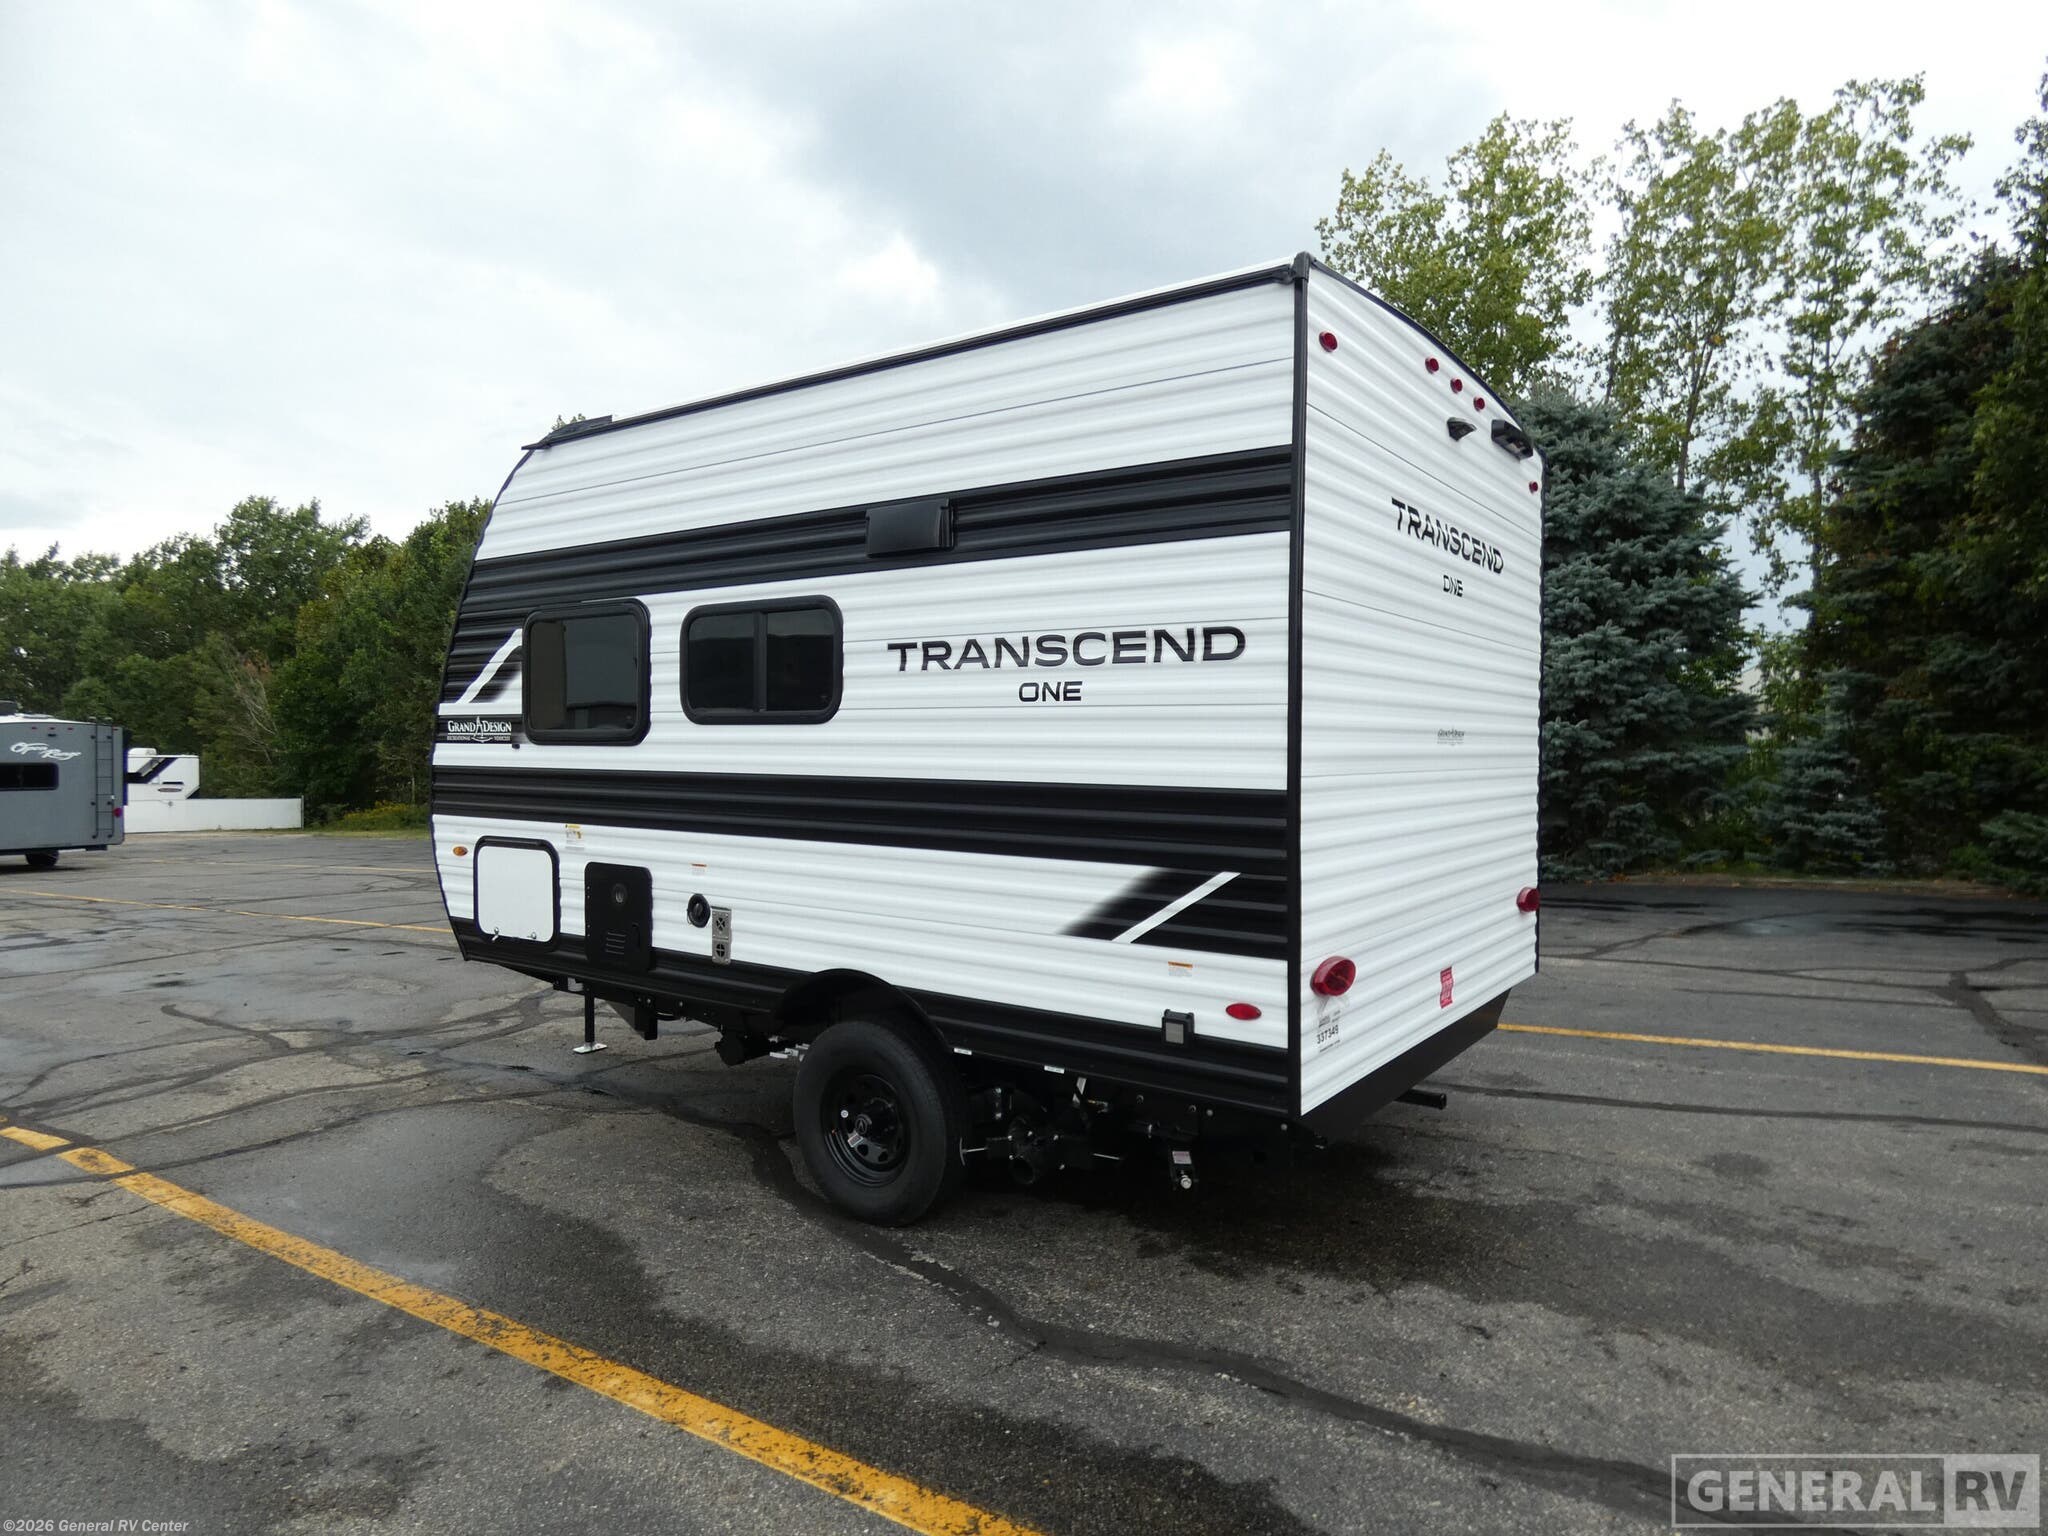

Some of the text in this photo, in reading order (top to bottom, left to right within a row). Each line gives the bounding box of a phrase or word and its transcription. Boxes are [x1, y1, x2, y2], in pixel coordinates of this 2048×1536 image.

[1391, 497, 1504, 575] TRANSCEND
[1442, 574, 1463, 598] ONE
[887, 626, 1246, 671] TRANSCEND
[1018, 681, 1083, 702] ONE
